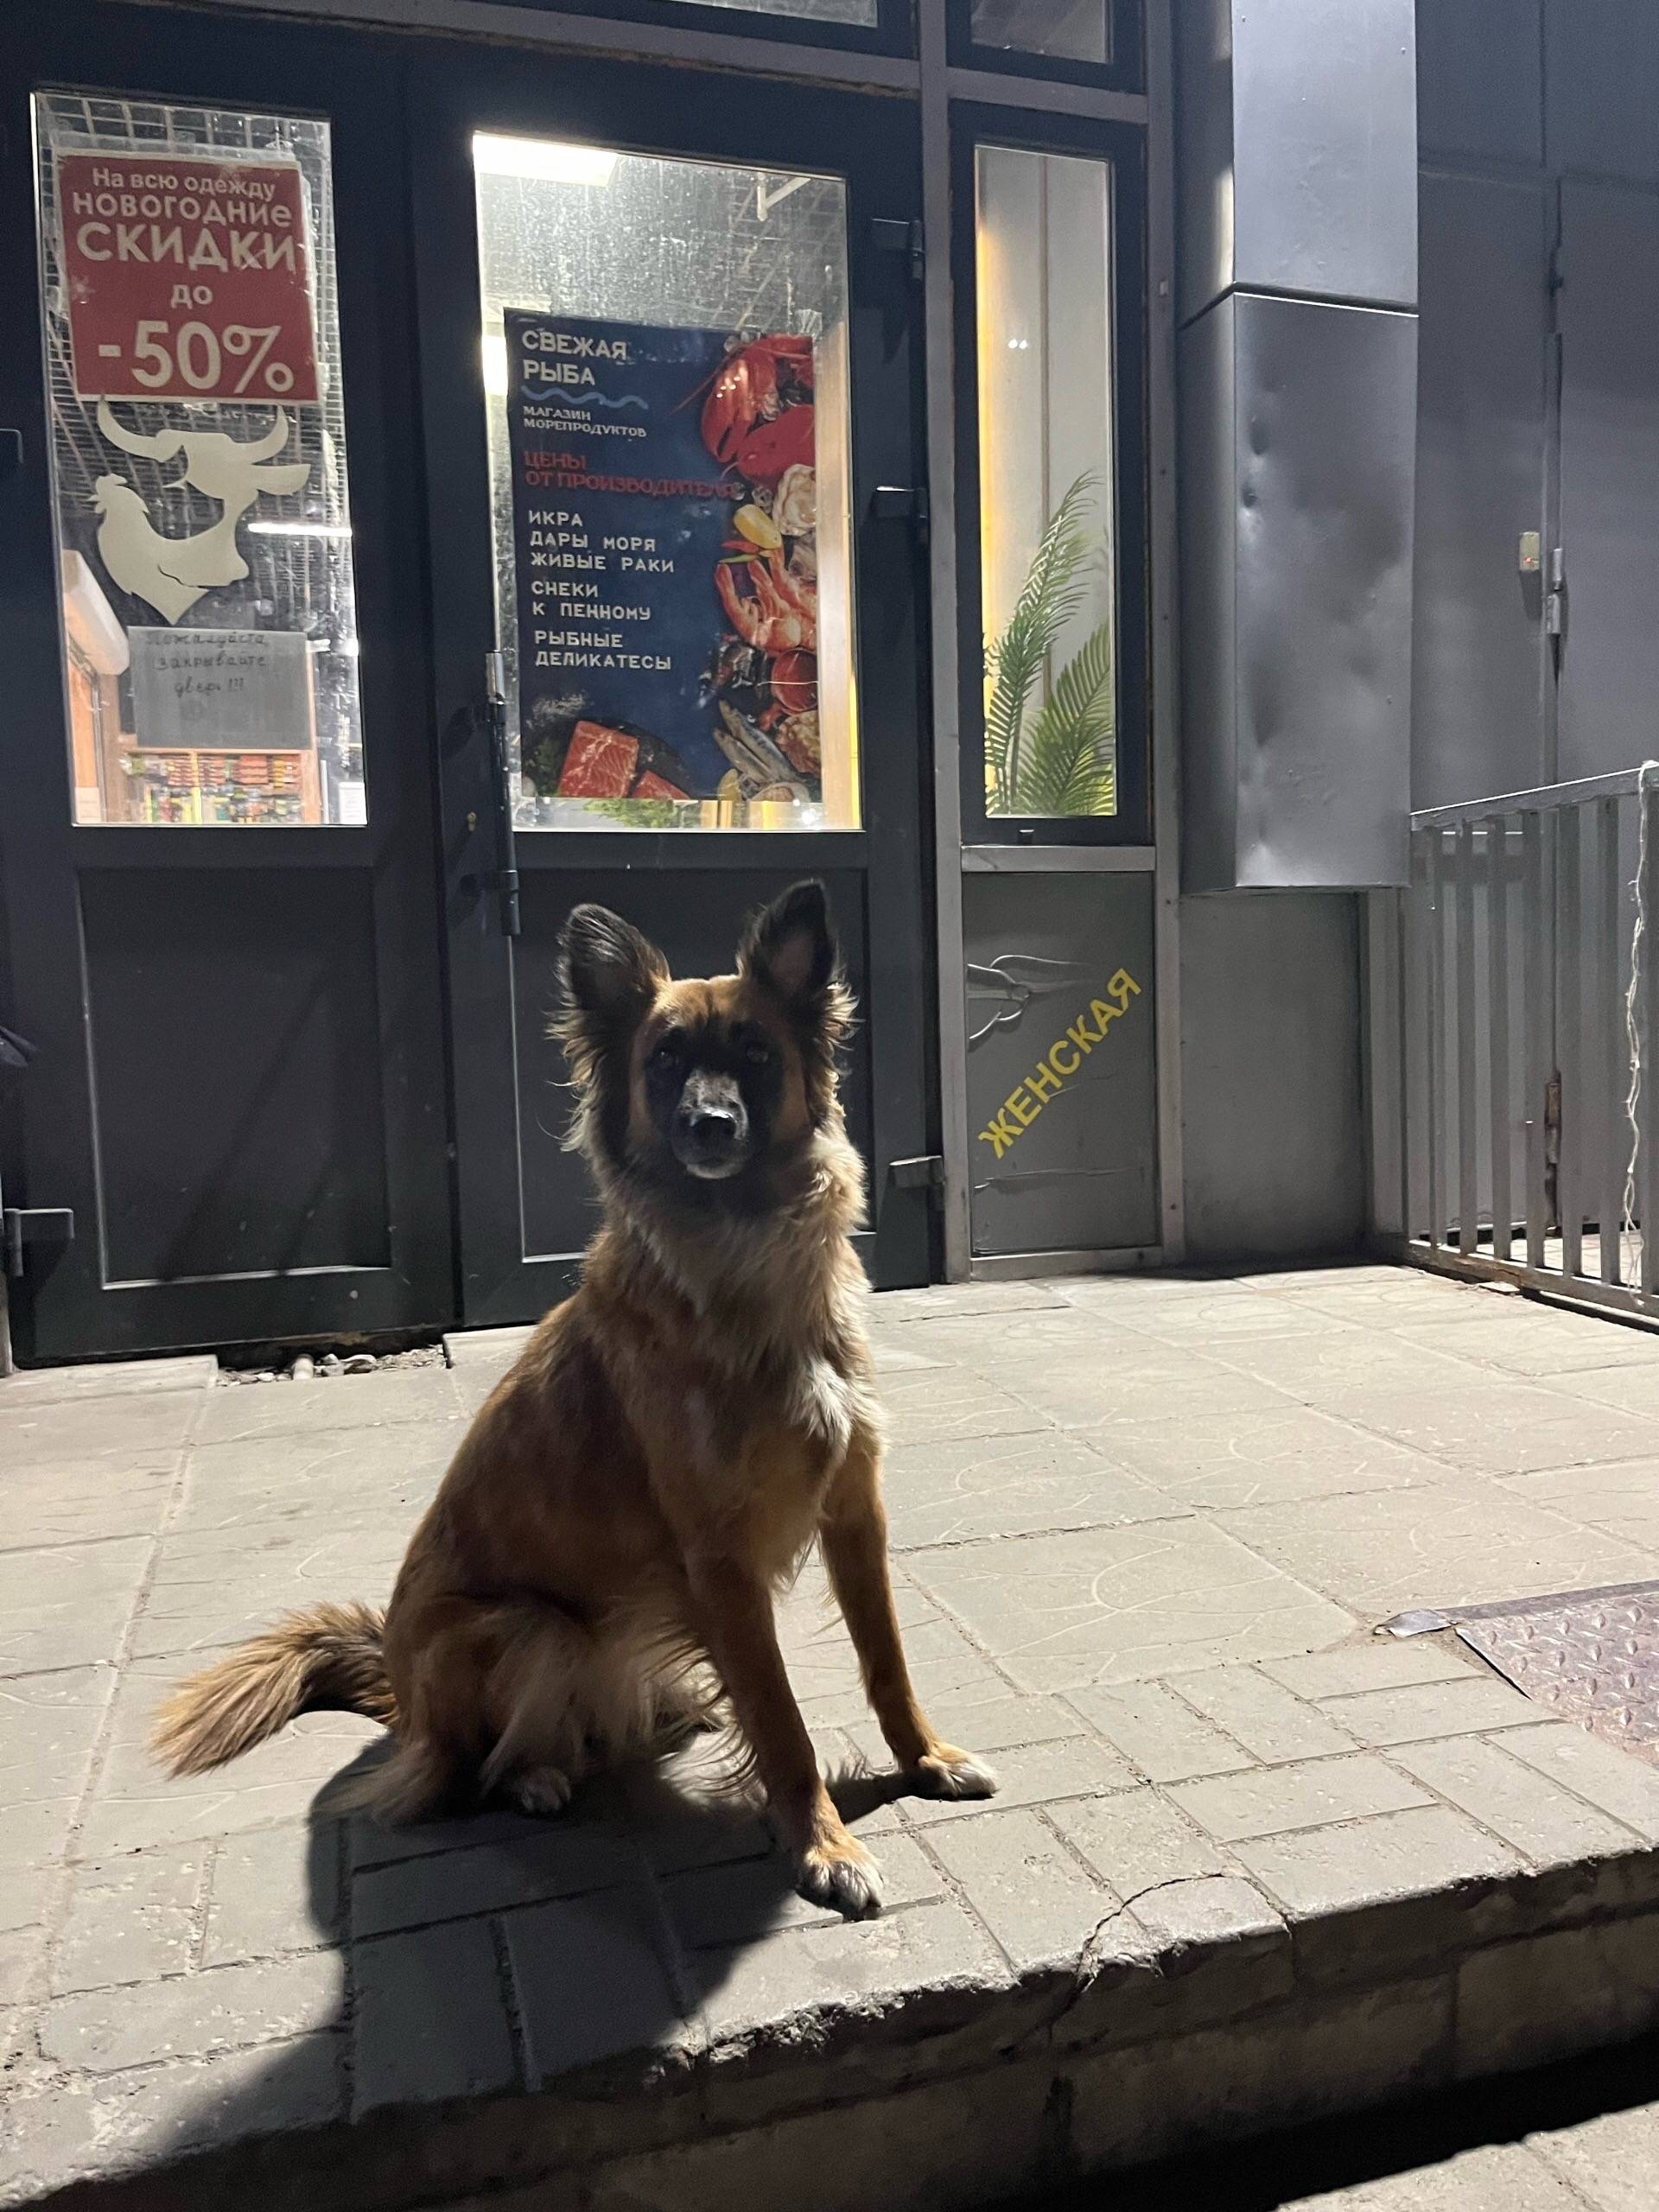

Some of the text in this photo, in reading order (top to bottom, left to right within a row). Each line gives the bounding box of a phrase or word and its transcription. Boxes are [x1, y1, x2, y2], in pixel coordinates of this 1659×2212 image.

[92, 167, 276, 201] На всю одежду
[77, 221, 296, 275] СКИДКИ
[170, 284, 213, 309] до
[521, 330, 627, 360] СВЕЖАЯ
[524, 360, 595, 385] РЫБА
[524, 406, 591, 421] МАГАЗИН
[524, 418, 646, 437] МОРЕПРОДУКТОВ
[524, 450, 586, 469] ЦЕНЫ
[526, 471, 734, 499] ОТ ПРОИЗВОДИТЕЛЯ
[529, 511, 582, 527] ИКРА
[530, 531, 655, 552] ДАРЫ МОРЯ
[531, 553, 674, 573] ЖИВЫЕ РАКИ
[531, 581, 598, 597] СНЕКИ
[533, 602, 651, 620] К ПЕННОМУ
[535, 631, 622, 648] РЫБНЫЕ
[536, 652, 671, 671] ДЕЛИКАТЕСЫ
[978, 968, 1141, 1159] ЖЕНСКАЯ
